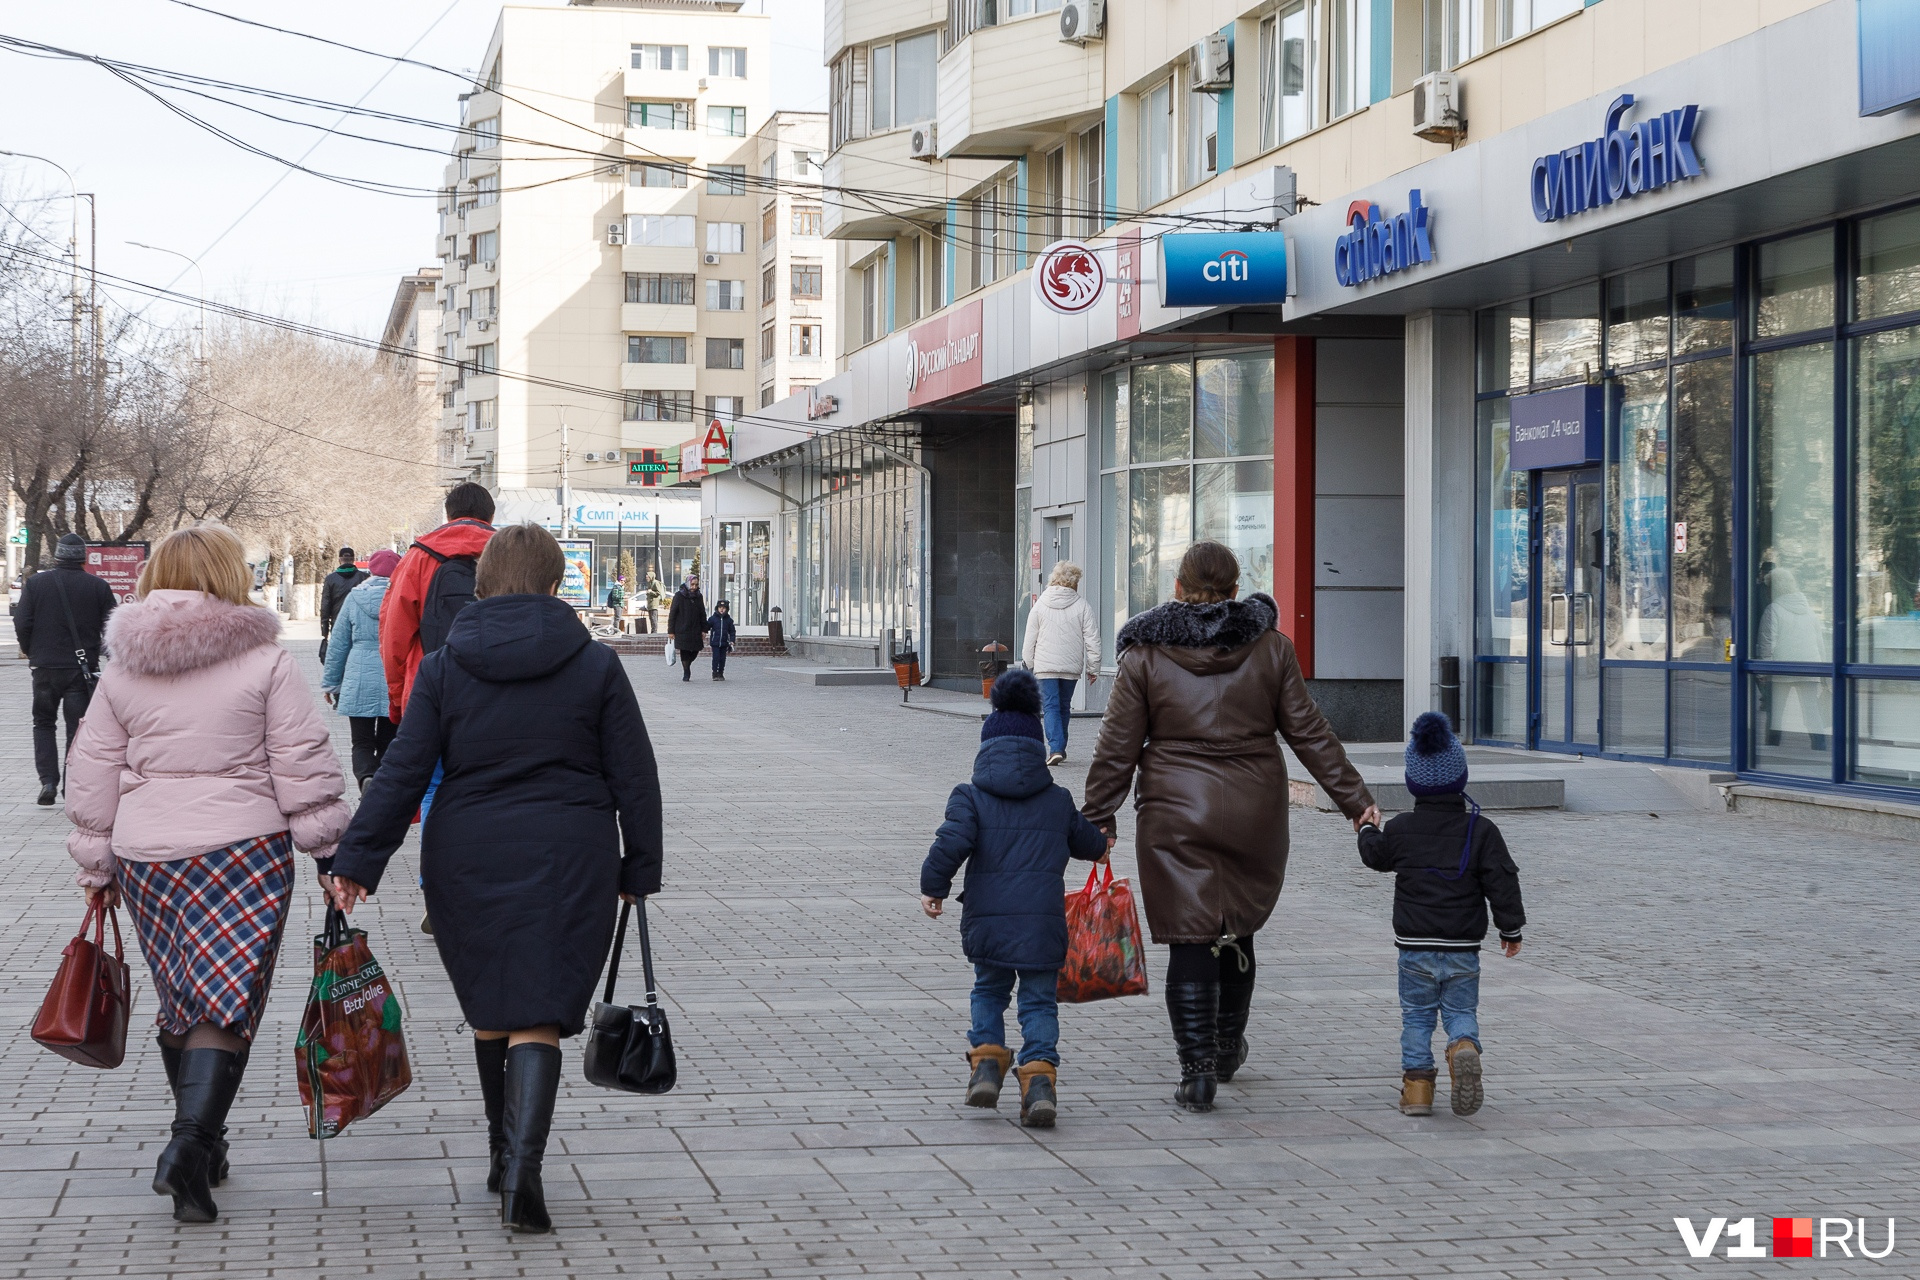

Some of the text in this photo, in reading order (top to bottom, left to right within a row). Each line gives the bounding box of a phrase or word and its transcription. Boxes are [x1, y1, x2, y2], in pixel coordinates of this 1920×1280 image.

[1531, 93, 1701, 224] ситибанк
[1334, 188, 1432, 288] citibank
[1202, 251, 1249, 283] citi
[1119, 266, 1132, 304] 24
[1515, 419, 1580, 442] Банкомат 24 часа
[631, 463, 666, 472] АПТЕКА
[587, 510, 614, 521] СМП
